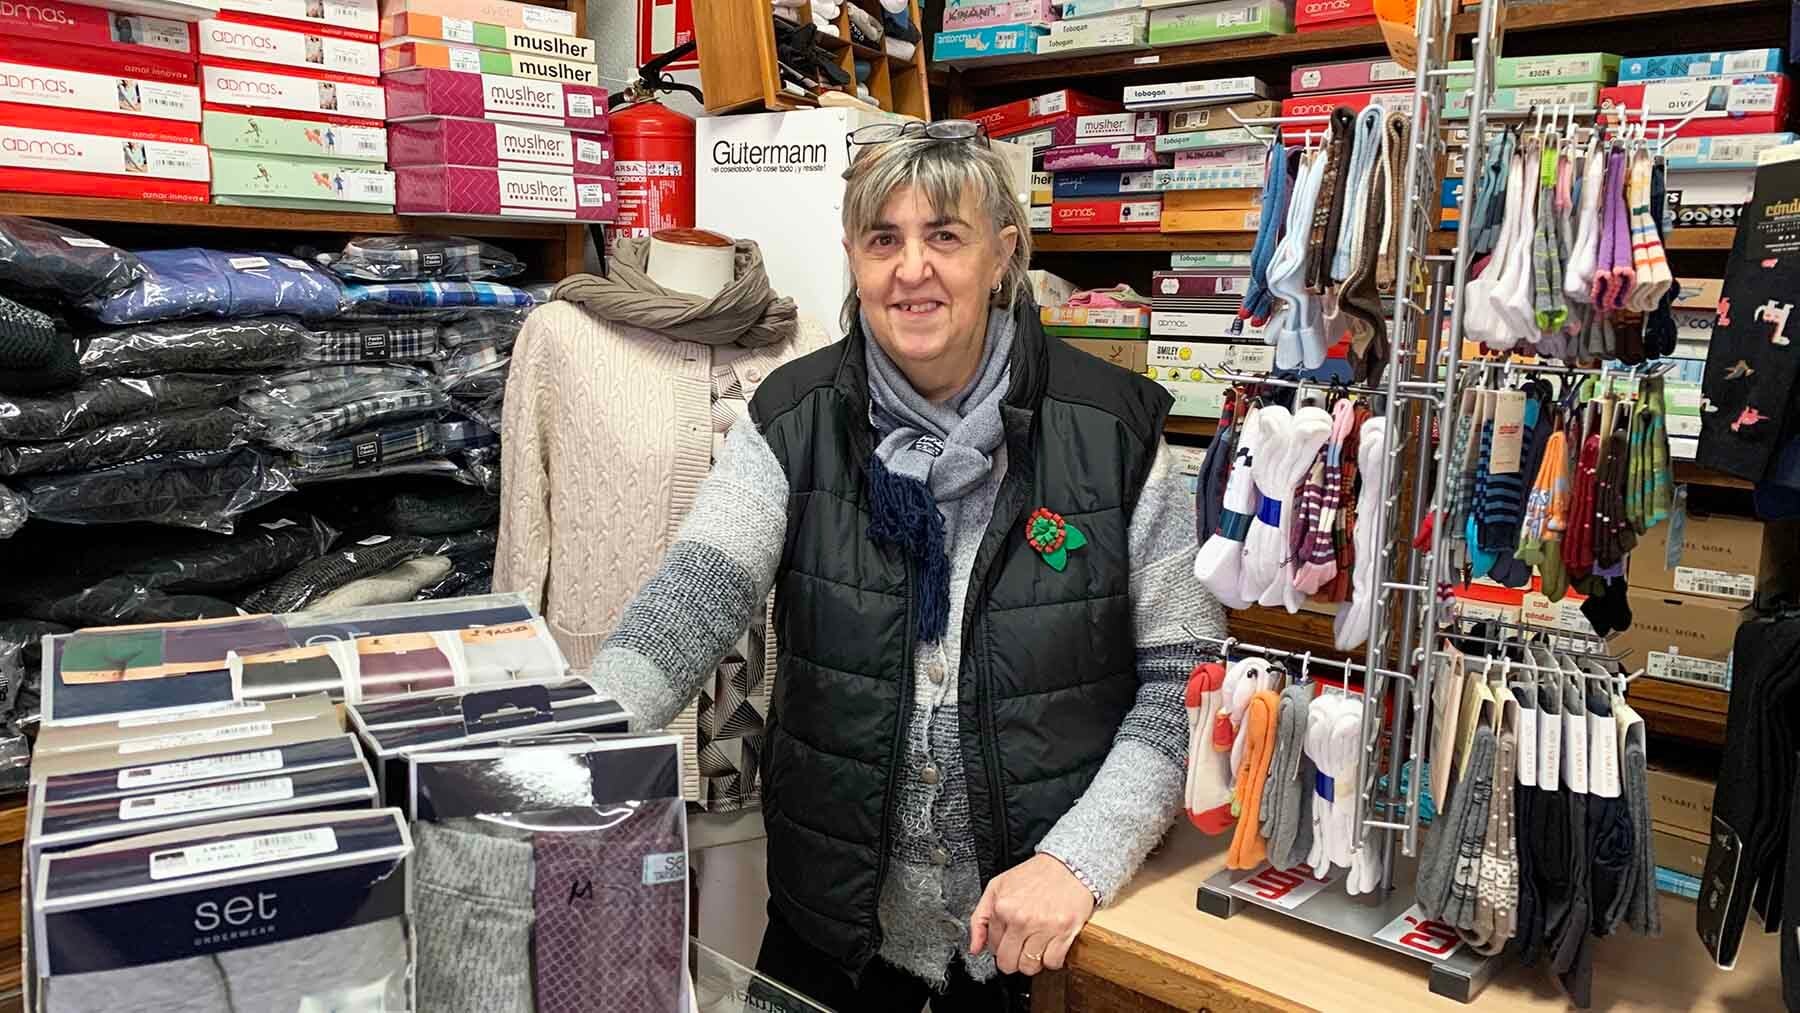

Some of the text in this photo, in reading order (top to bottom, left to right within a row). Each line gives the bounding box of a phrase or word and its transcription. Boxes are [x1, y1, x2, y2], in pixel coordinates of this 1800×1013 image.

[513, 33, 588, 58] muslher
[519, 60, 592, 82] muslher
[491, 86, 553, 103] muslher
[1084, 119, 1124, 131] muslher
[504, 134, 562, 151] muslher
[713, 140, 827, 165] Gütermann
[507, 180, 565, 197] muslher
[194, 892, 278, 931] set
